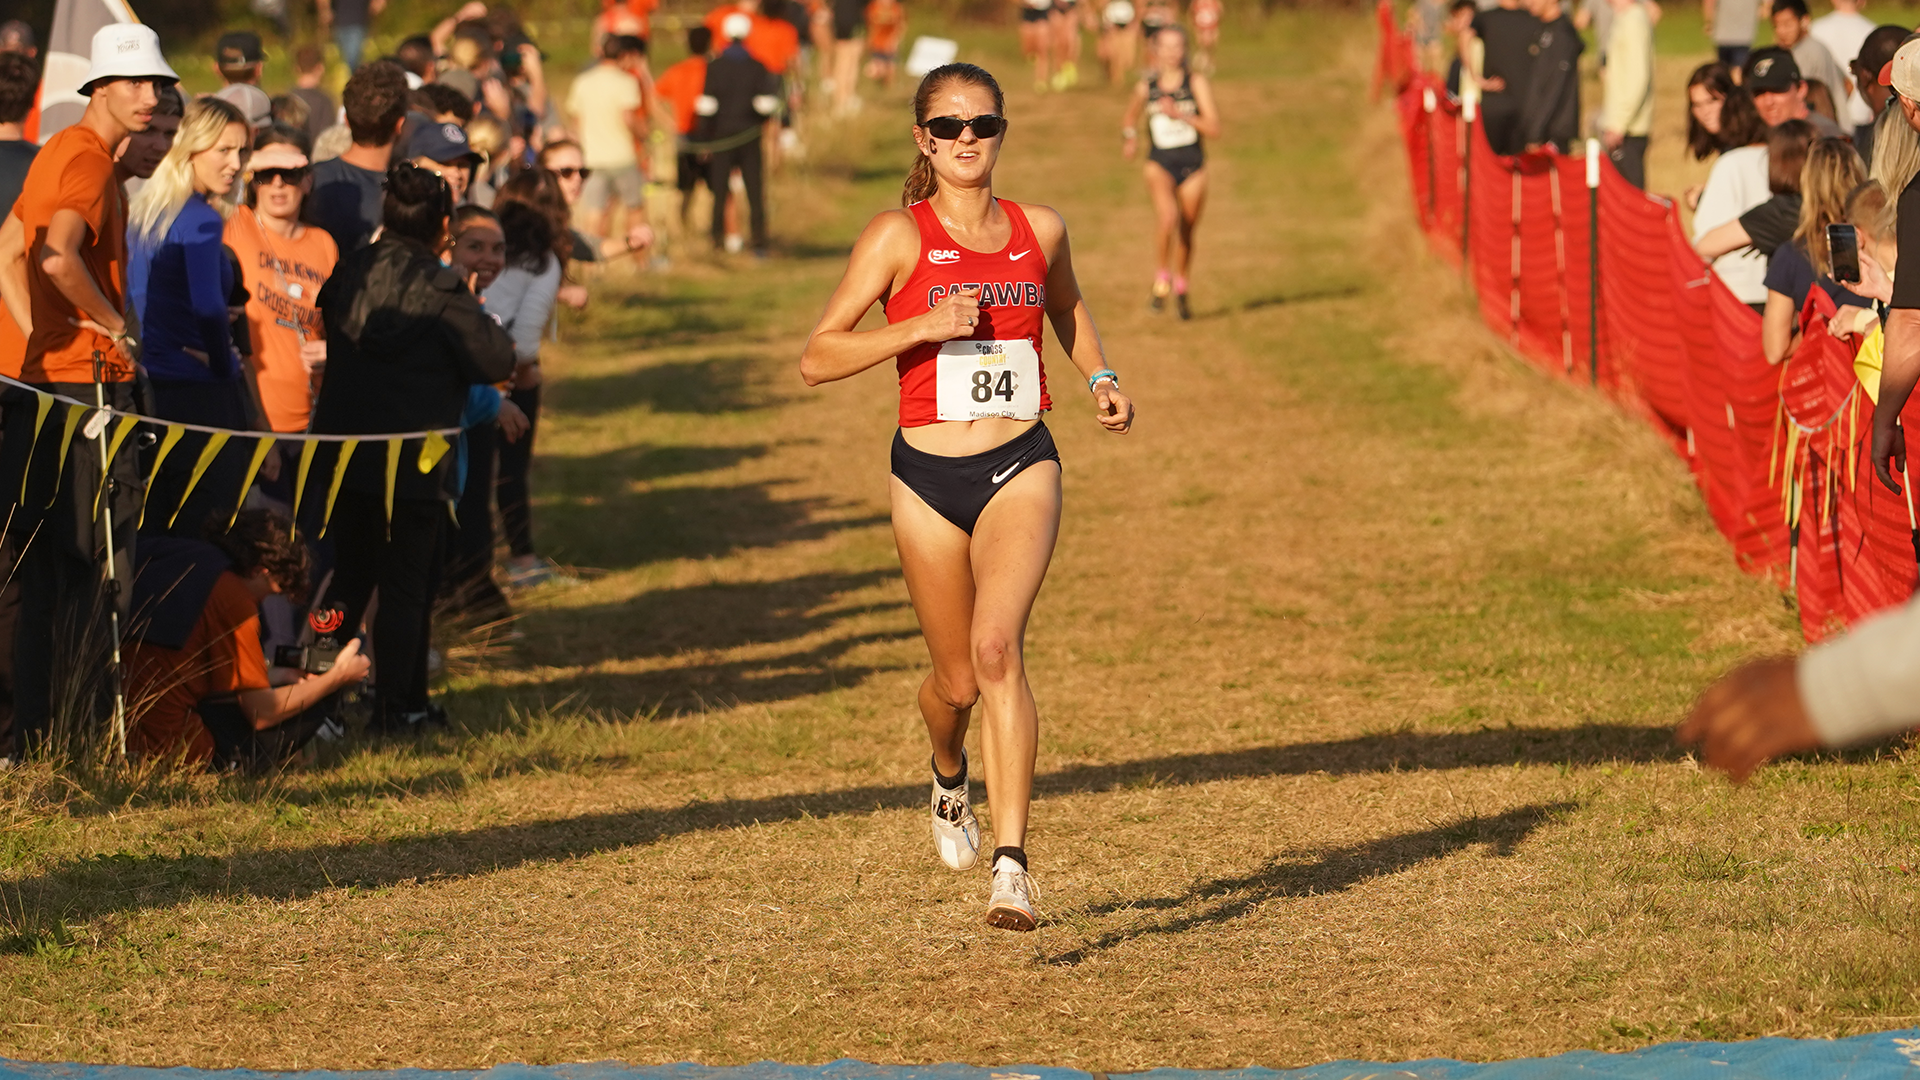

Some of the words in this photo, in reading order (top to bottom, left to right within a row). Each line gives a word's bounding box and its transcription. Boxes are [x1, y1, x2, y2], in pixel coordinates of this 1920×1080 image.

[929, 138, 938, 155] C
[931, 249, 960, 261] SAC
[257, 282, 291, 317] CROSS
[982, 344, 1003, 355] CROSS
[979, 354, 1007, 366] COUNTRY
[971, 370, 1014, 403] 84
[1001, 410, 1016, 418] Clay
